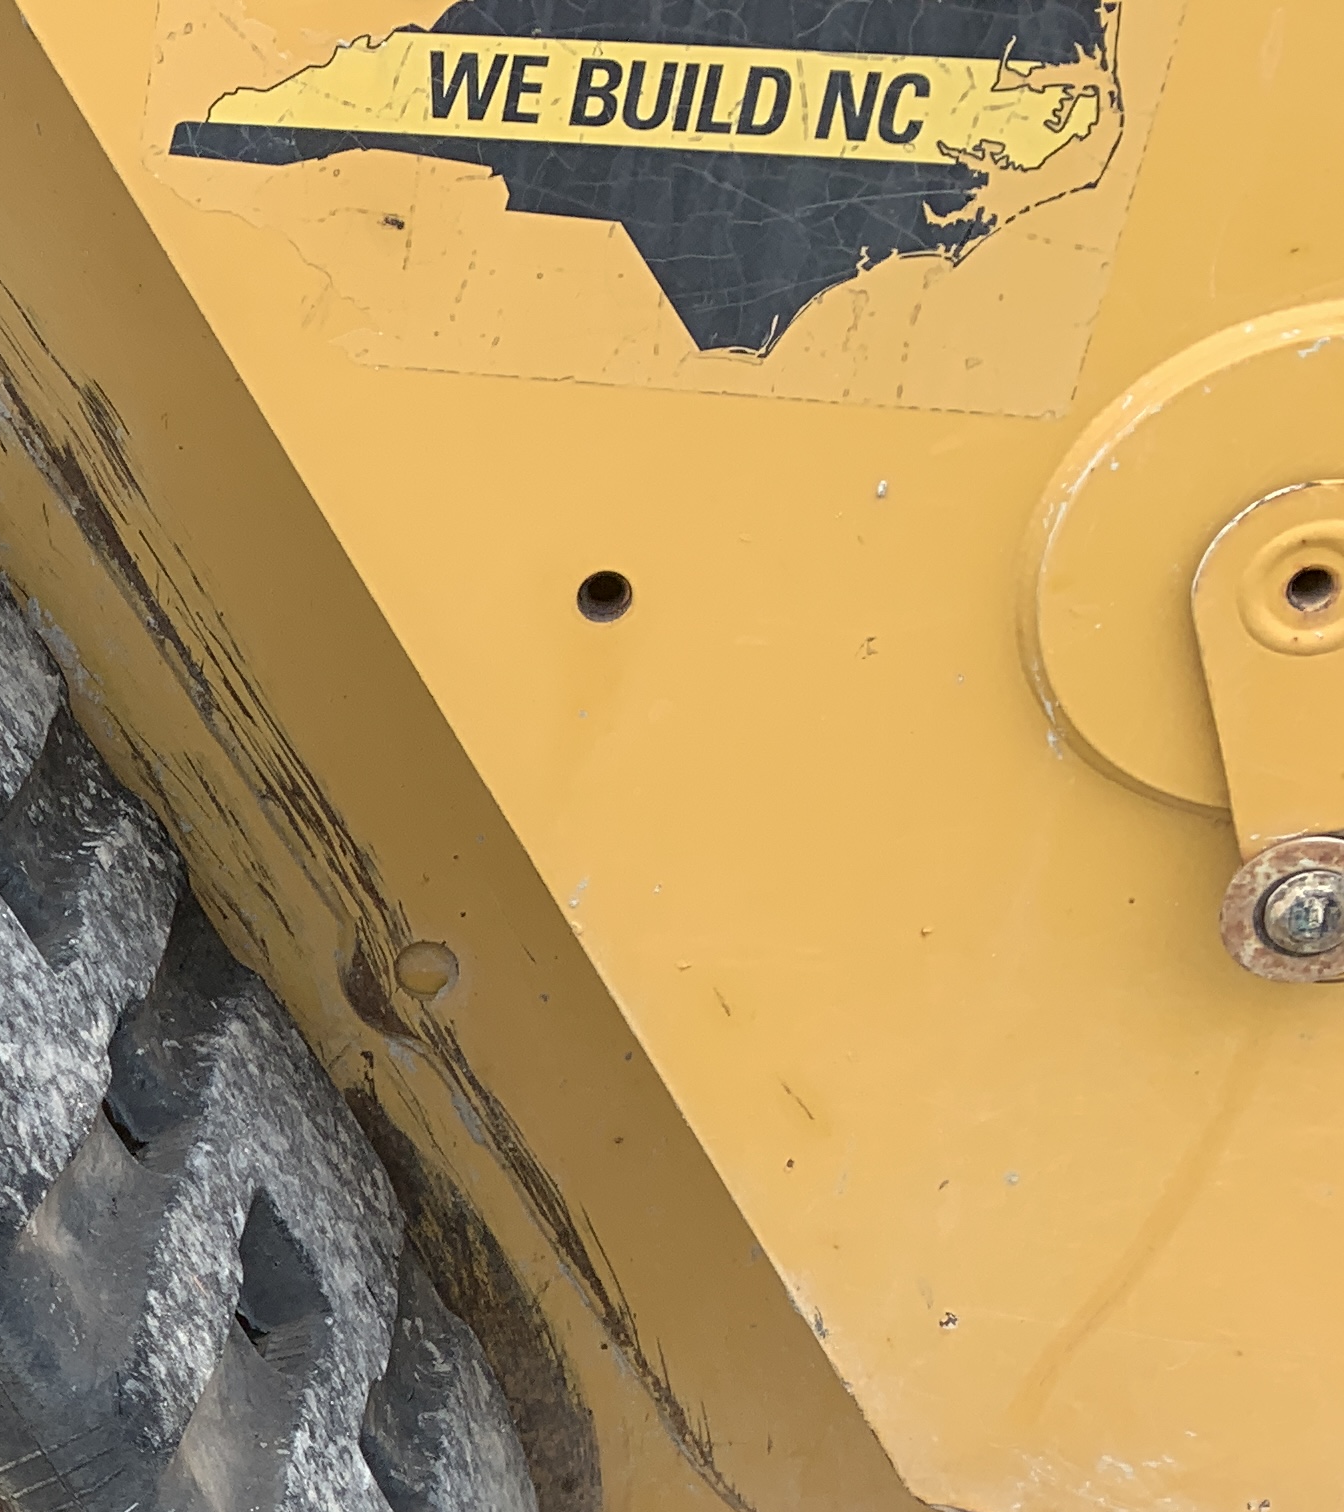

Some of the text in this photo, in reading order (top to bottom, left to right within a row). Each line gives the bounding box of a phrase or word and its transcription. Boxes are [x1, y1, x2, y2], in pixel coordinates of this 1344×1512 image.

[429, 50, 931, 145] WE BUILD NC
